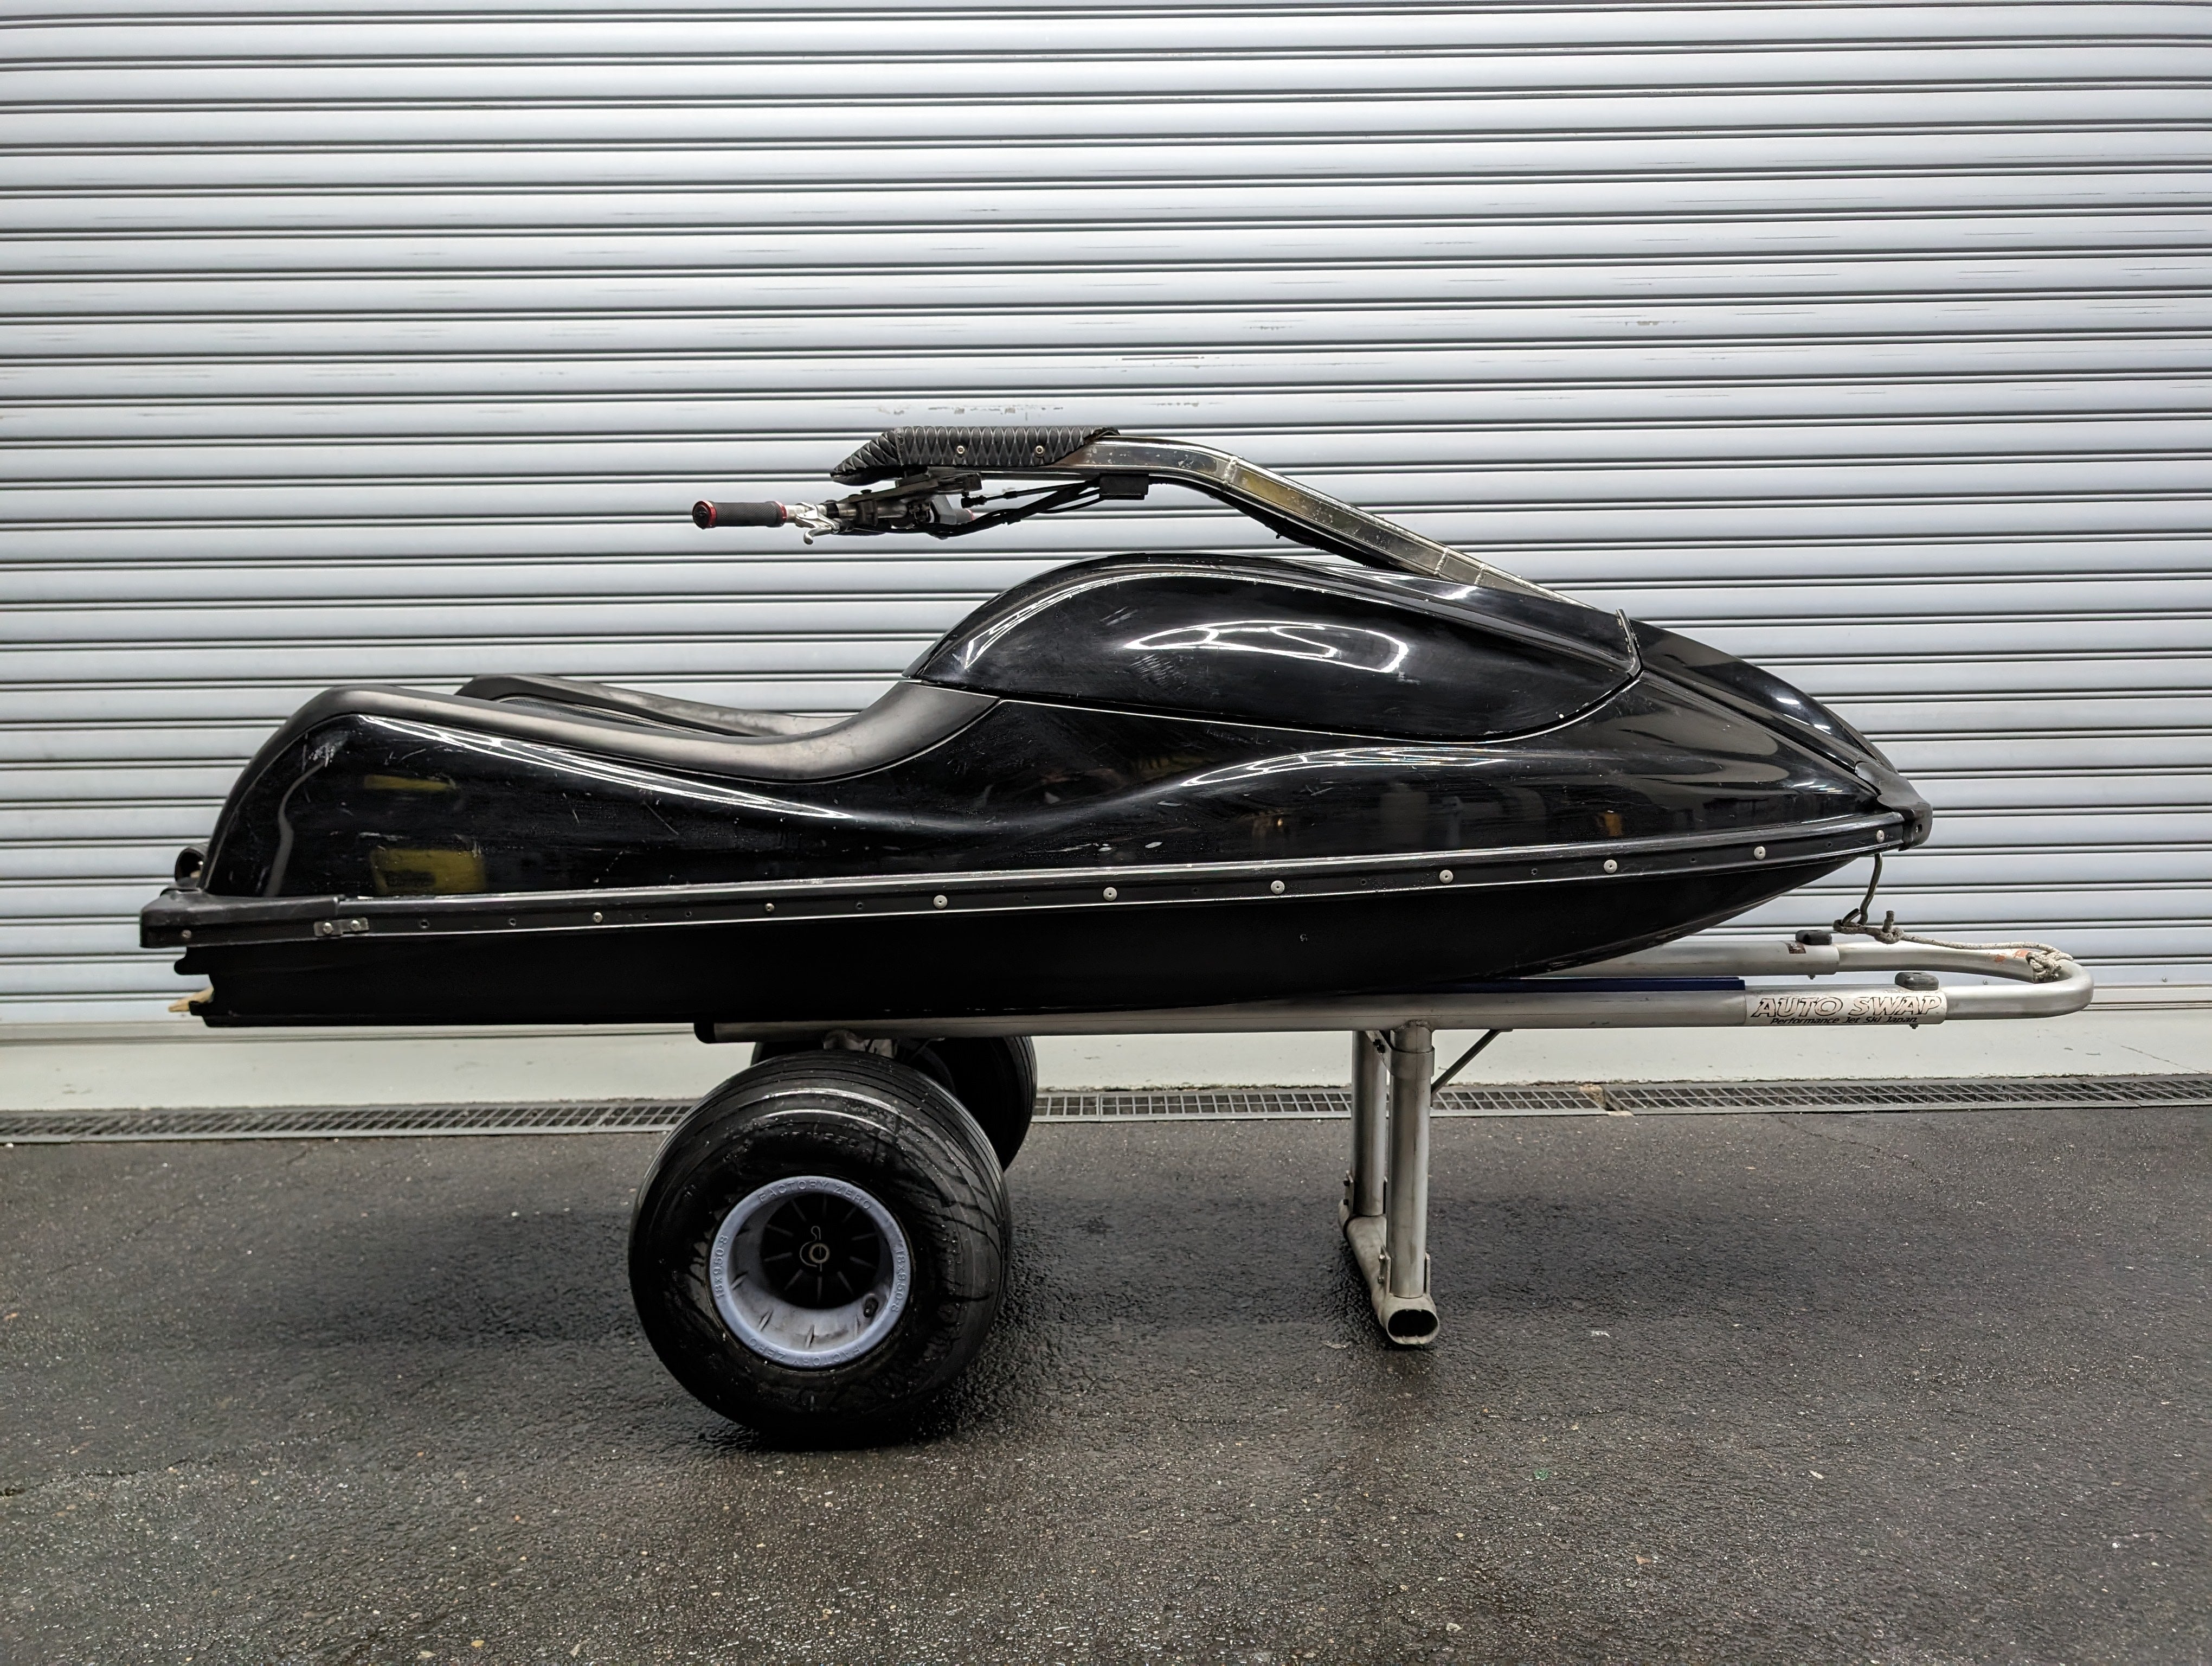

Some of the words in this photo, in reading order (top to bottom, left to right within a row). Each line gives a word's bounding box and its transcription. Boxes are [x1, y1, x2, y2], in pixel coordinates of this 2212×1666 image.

[1751, 997, 1843, 1017] AUTO
[1848, 996, 1942, 1016] SWAP
[758, 1180, 829, 1202] FACTORY
[833, 1184, 871, 1209] ZERO
[749, 1337, 786, 1362] ZERO
[792, 1345, 862, 1366] FACTORY
